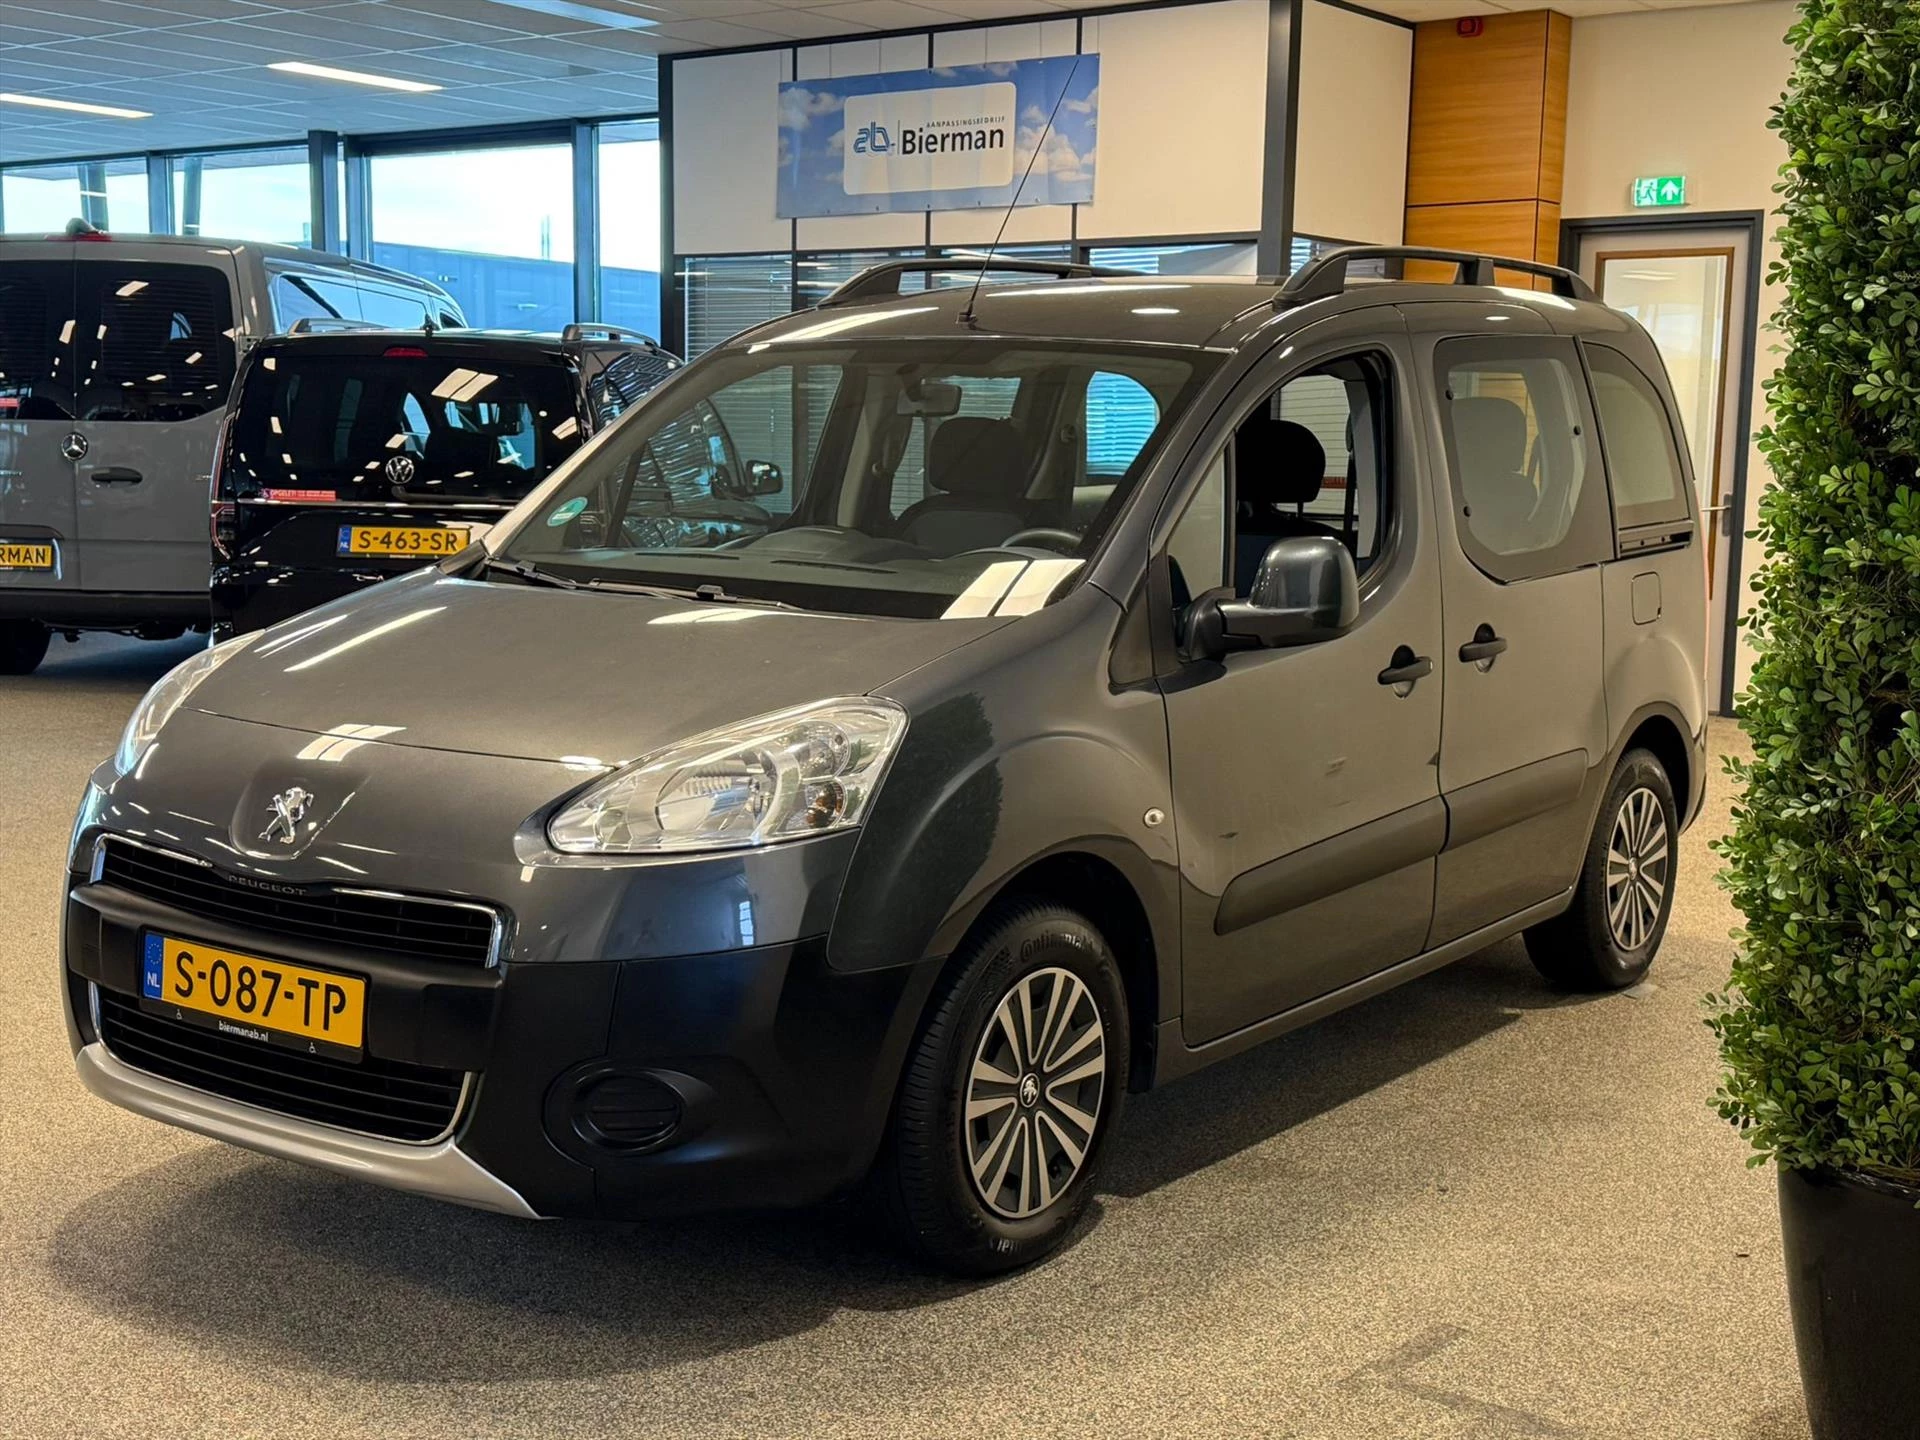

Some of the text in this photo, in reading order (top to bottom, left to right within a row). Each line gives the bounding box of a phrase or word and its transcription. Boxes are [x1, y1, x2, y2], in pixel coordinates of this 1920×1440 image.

[926, 116, 1005, 128] AANPASSINGSBEDRIJF
[902, 127, 1004, 155] Bierman
[358, 530, 458, 551] S-463-SR
[228, 875, 307, 896] PEUGEOT
[147, 950, 346, 1032] NL S-087-TP
[218, 1020, 269, 1043] biermanab.nl
